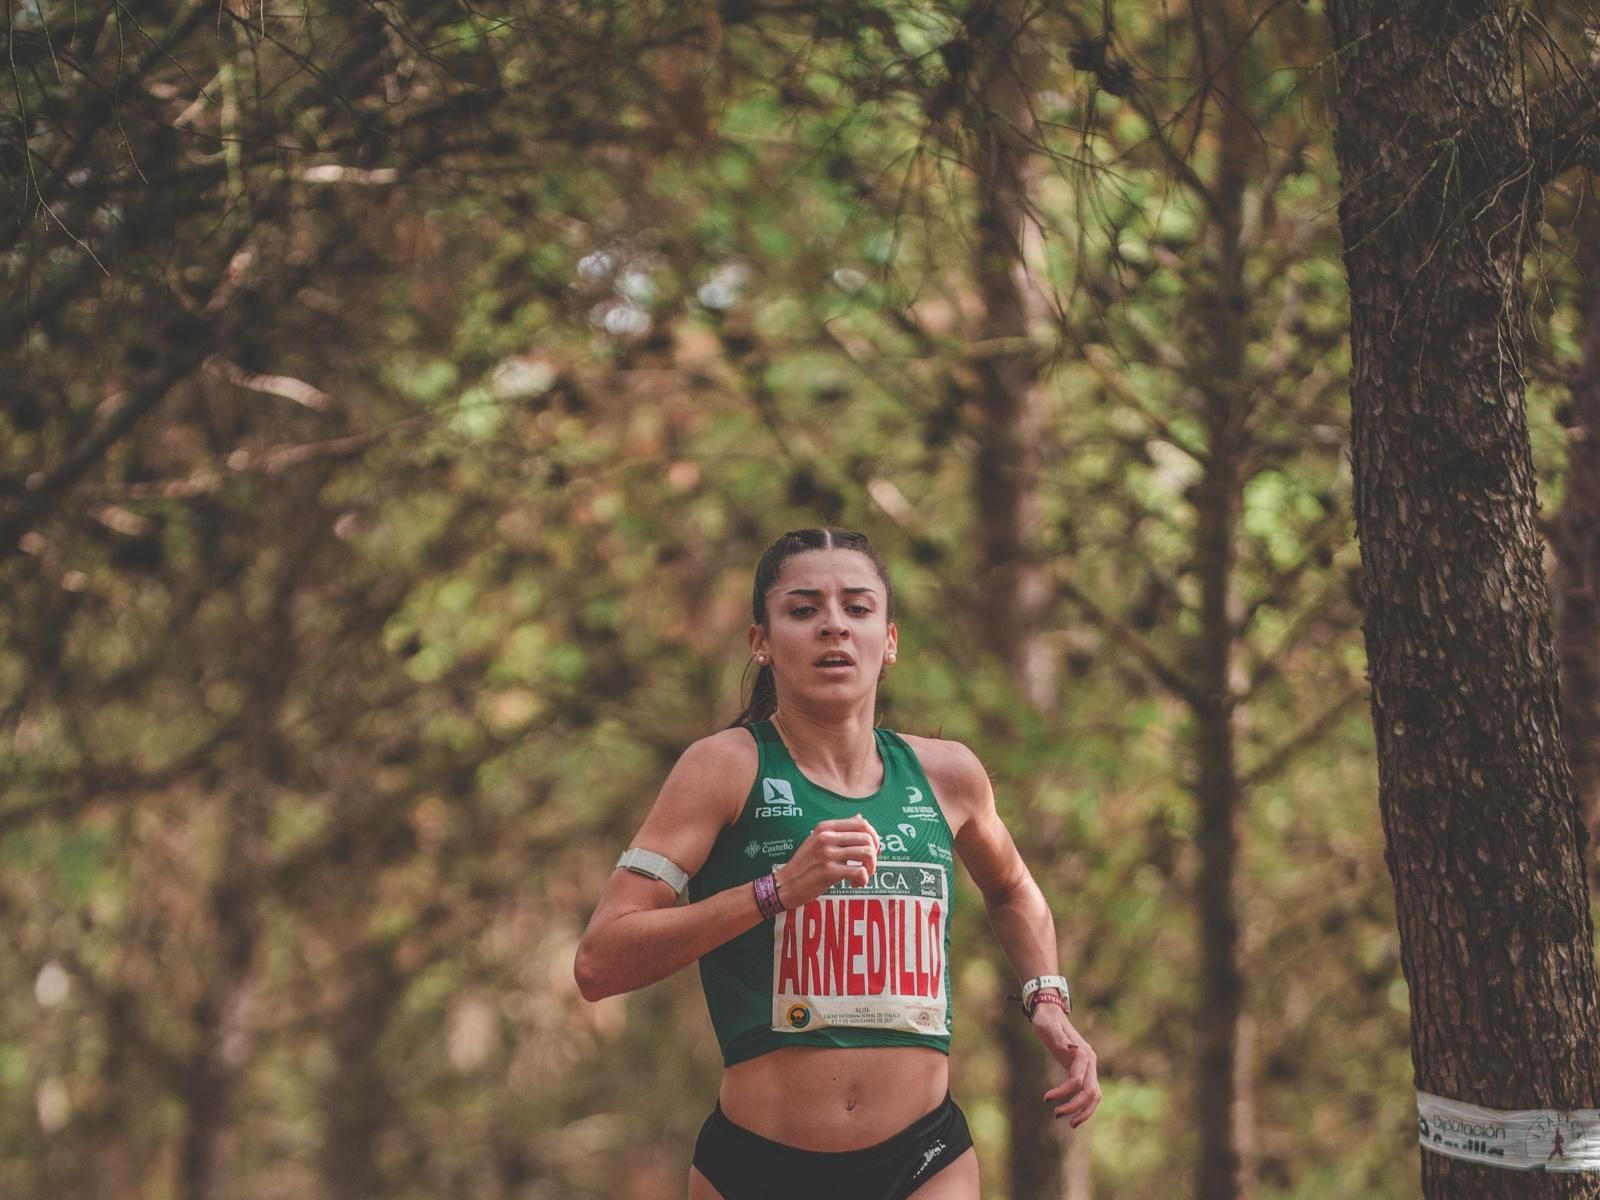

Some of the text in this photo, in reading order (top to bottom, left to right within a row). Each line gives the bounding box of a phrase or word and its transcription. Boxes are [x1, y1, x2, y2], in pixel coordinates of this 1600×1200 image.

[755, 804, 803, 819] rasán
[778, 899, 941, 999] ARNEDILLO
[1432, 1114, 1506, 1139] Diputación
